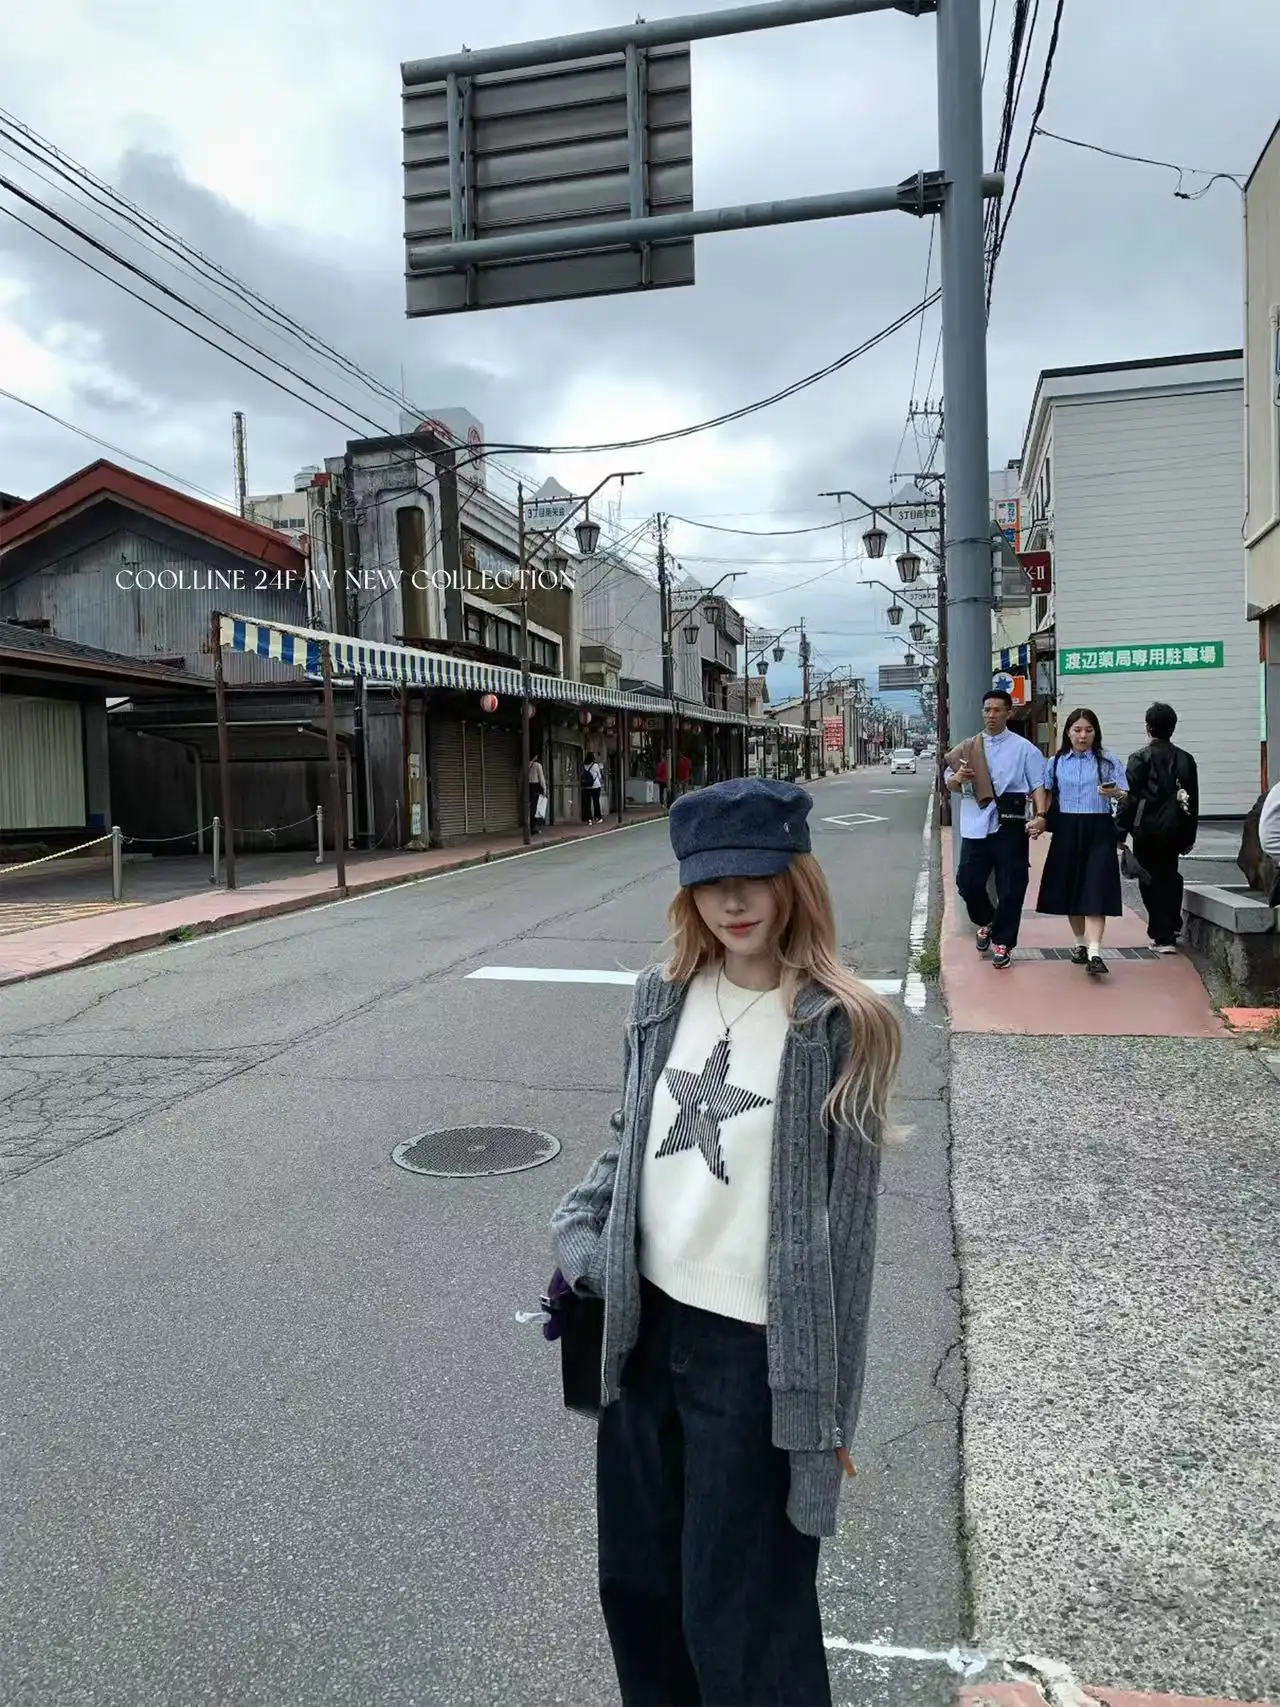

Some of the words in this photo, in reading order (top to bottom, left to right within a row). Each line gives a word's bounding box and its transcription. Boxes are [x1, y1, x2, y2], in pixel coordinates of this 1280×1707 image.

[1065, 645, 1216, 670] 渡辺薬局専用駐車場
